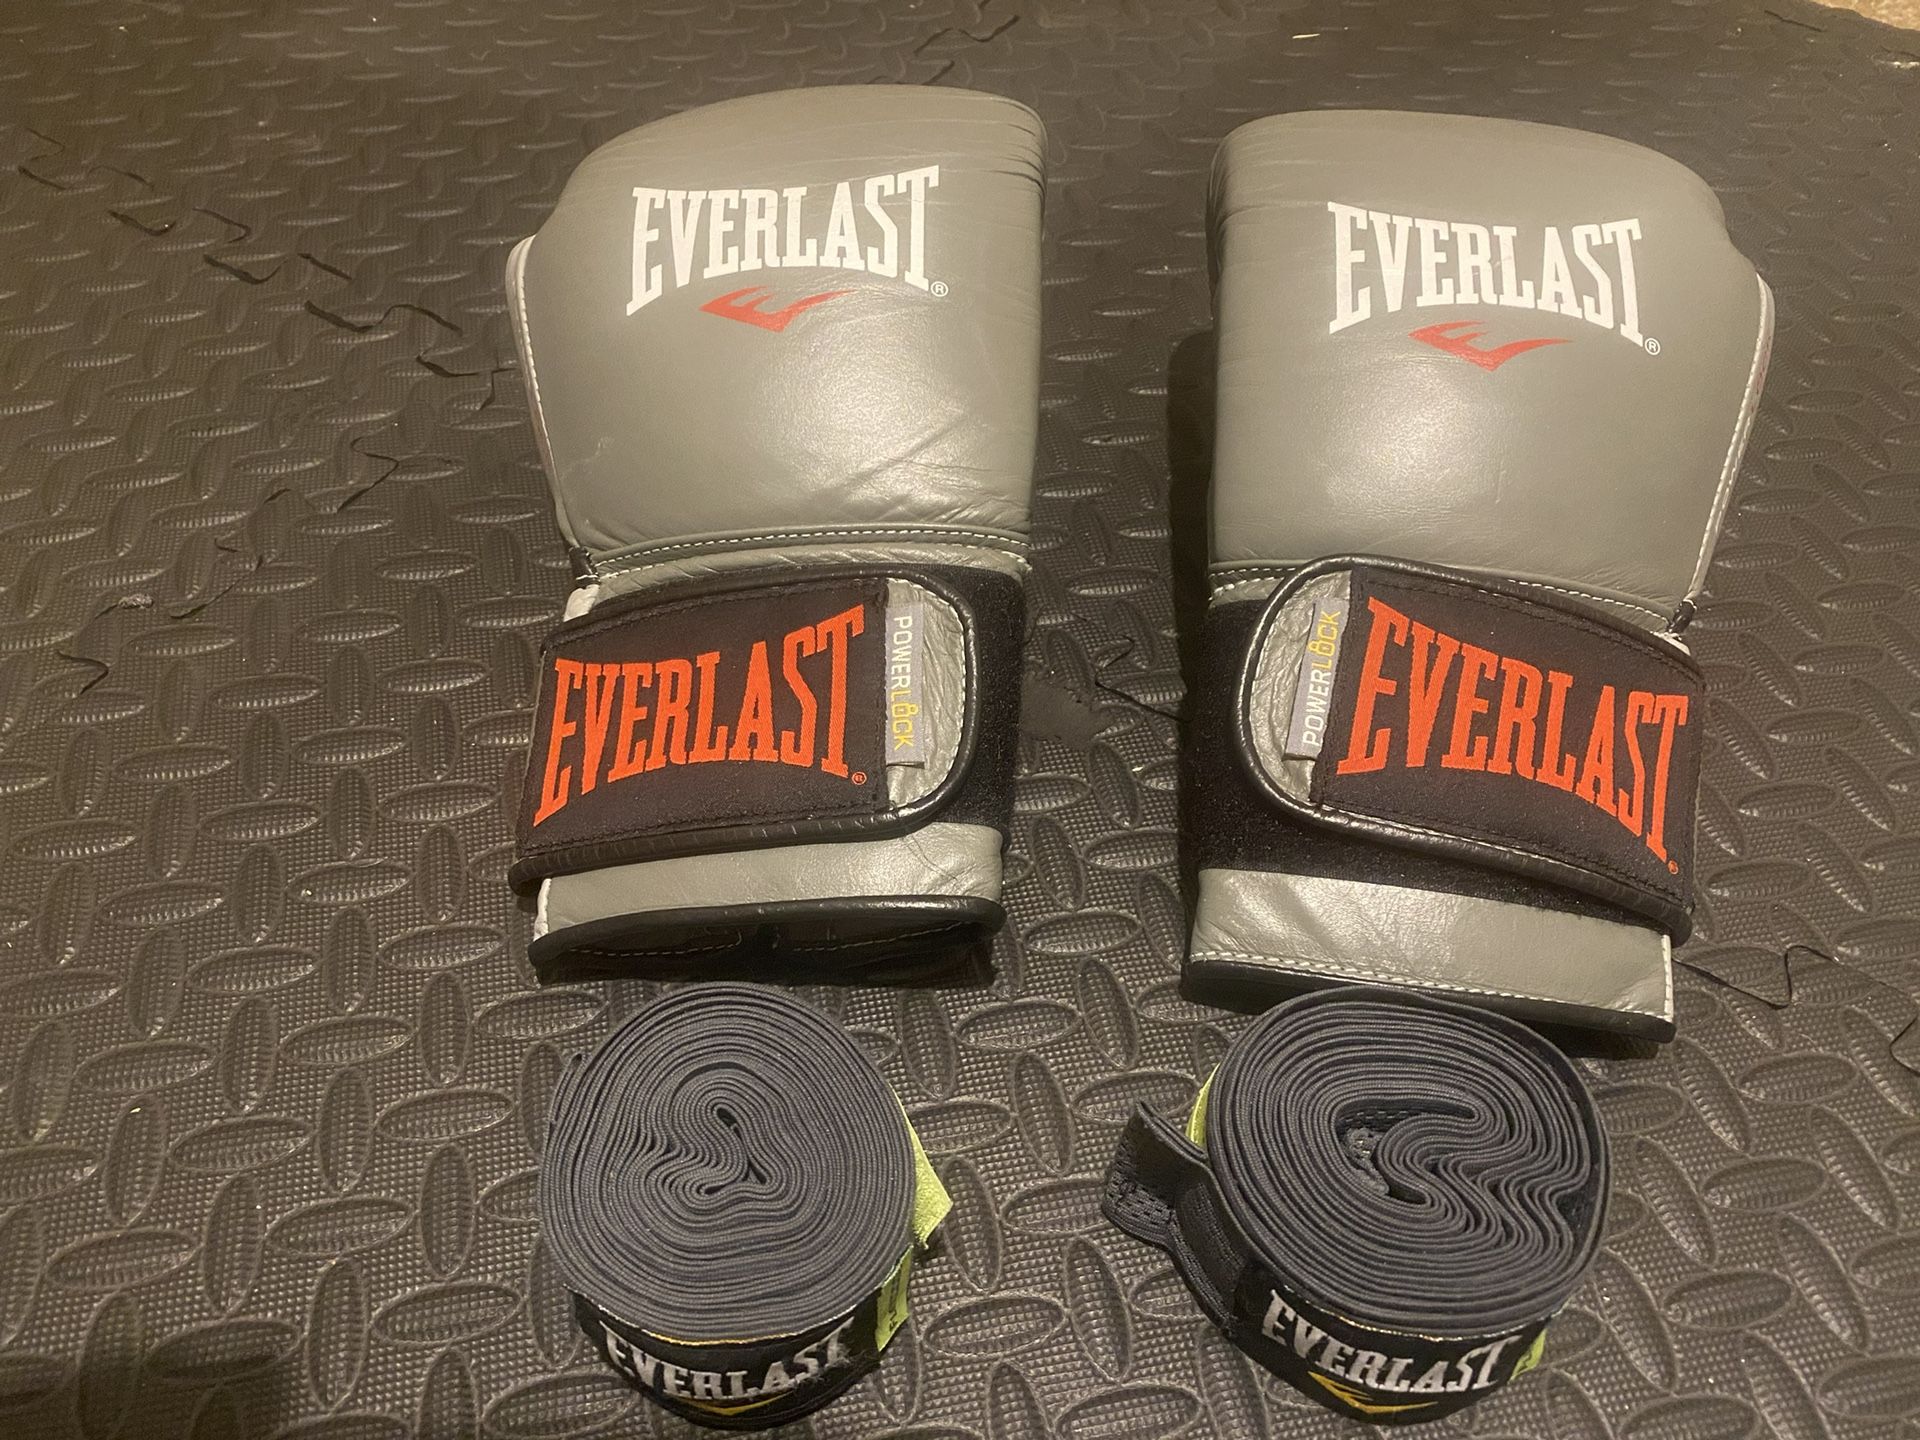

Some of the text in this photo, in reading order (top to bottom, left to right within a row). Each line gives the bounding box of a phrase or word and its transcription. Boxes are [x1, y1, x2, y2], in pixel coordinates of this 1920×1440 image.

[626, 164, 940, 317] EVERLAST
[1327, 201, 1644, 348] EVERLAST
[533, 603, 865, 827] EVERLAST
[891, 615, 919, 751] POWERLOCK
[1301, 610, 1342, 747] POWERLOCK
[1336, 596, 1689, 864] EVERLAST
[600, 1316, 855, 1401] EVERLAST
[1261, 1289, 1523, 1393] EVERLAST
